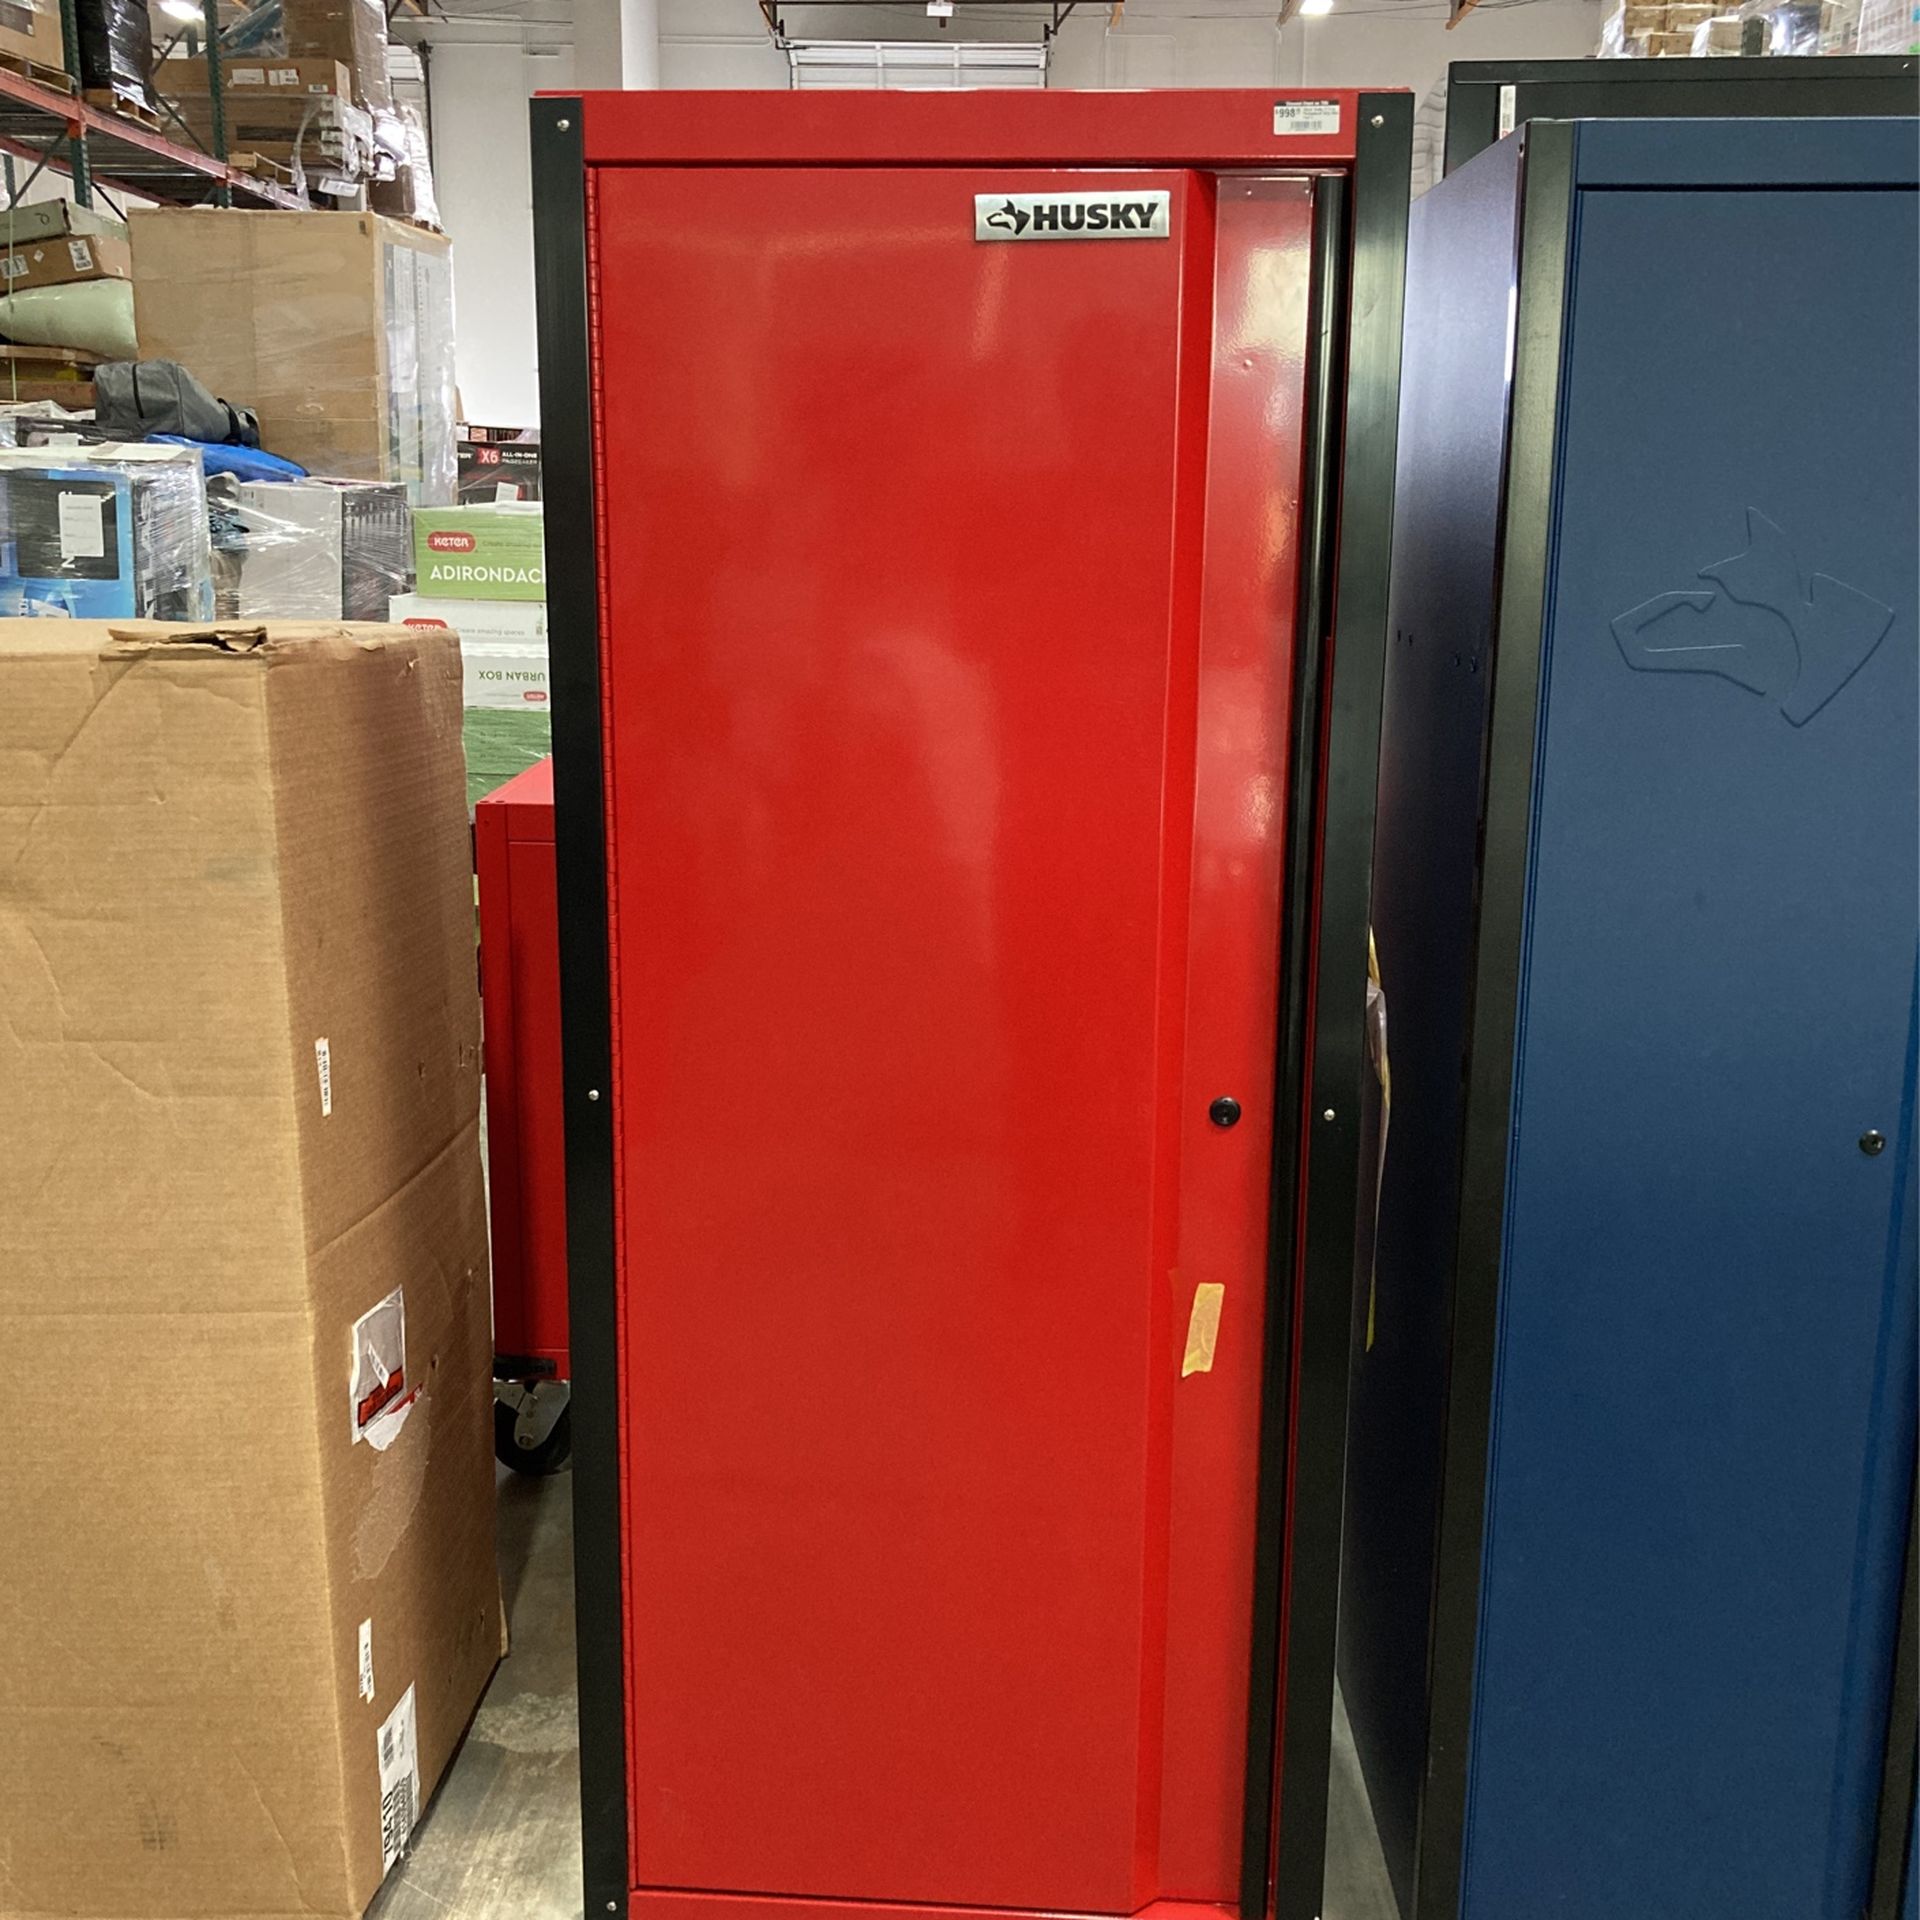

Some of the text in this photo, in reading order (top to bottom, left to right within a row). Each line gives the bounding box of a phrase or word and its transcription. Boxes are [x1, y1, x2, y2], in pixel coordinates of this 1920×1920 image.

[1033, 203, 1159, 231] HUSKY
[481, 450, 499, 464] X6
[433, 537, 469, 548] KETER
[430, 565, 545, 584] ADIRONDAC
[478, 669, 545, 681] URBAN BOX
